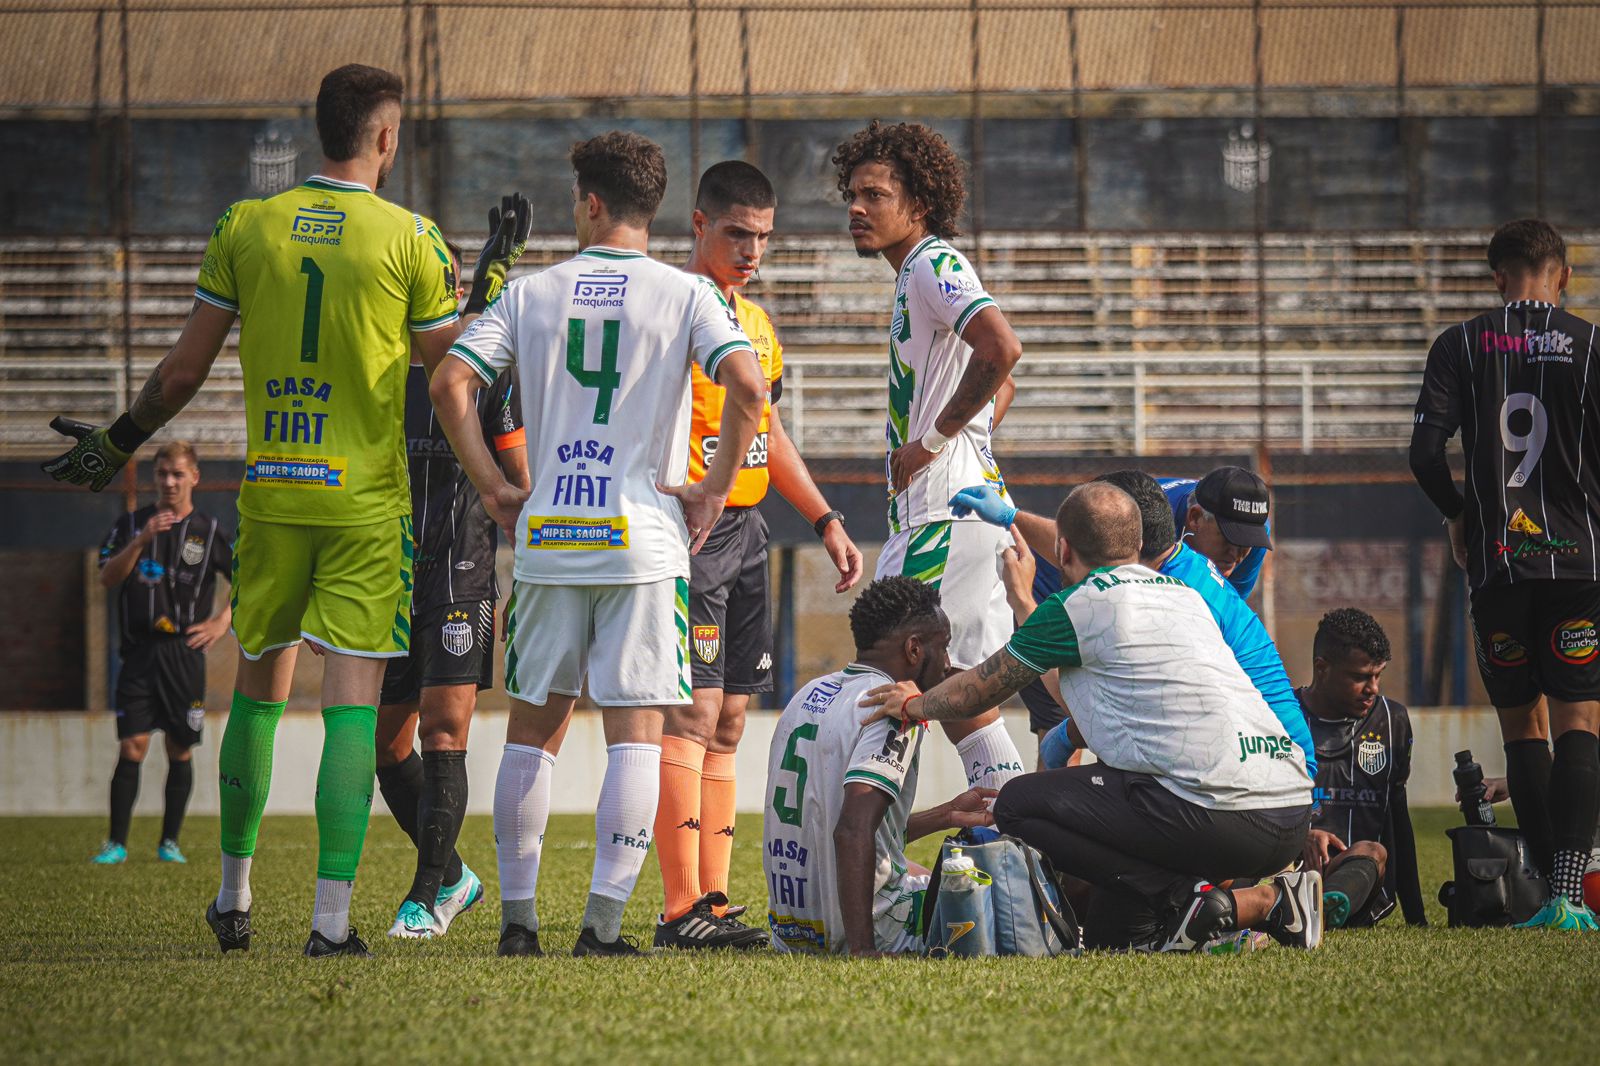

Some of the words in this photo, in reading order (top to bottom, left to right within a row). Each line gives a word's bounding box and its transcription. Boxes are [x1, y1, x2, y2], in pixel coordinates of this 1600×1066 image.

[290, 234, 341, 246] maquinas
[300, 256, 325, 363] 1
[572, 297, 624, 309] maquinas
[1527, 354, 1574, 364] DSRIBUIDORA
[566, 318, 622, 425] 4
[265, 376, 333, 403] CASA
[292, 399, 304, 408] DO
[263, 410, 329, 445] FIAT
[1499, 392, 1549, 488] 9
[556, 439, 615, 466] CASA
[257, 464, 289, 476] HIPER
[291, 465, 326, 478] SAÚDE
[576, 462, 587, 471] DO
[552, 474, 612, 508] FIAT
[542, 527, 572, 539] HIPER
[576, 526, 609, 539] SAÚDE
[698, 628, 716, 638] FPF
[1561, 628, 1597, 640] Danilo
[1560, 637, 1600, 649] Lanches
[870, 753, 905, 776] HEADER
[772, 722, 819, 828] 5
[768, 838, 808, 868] ASA
